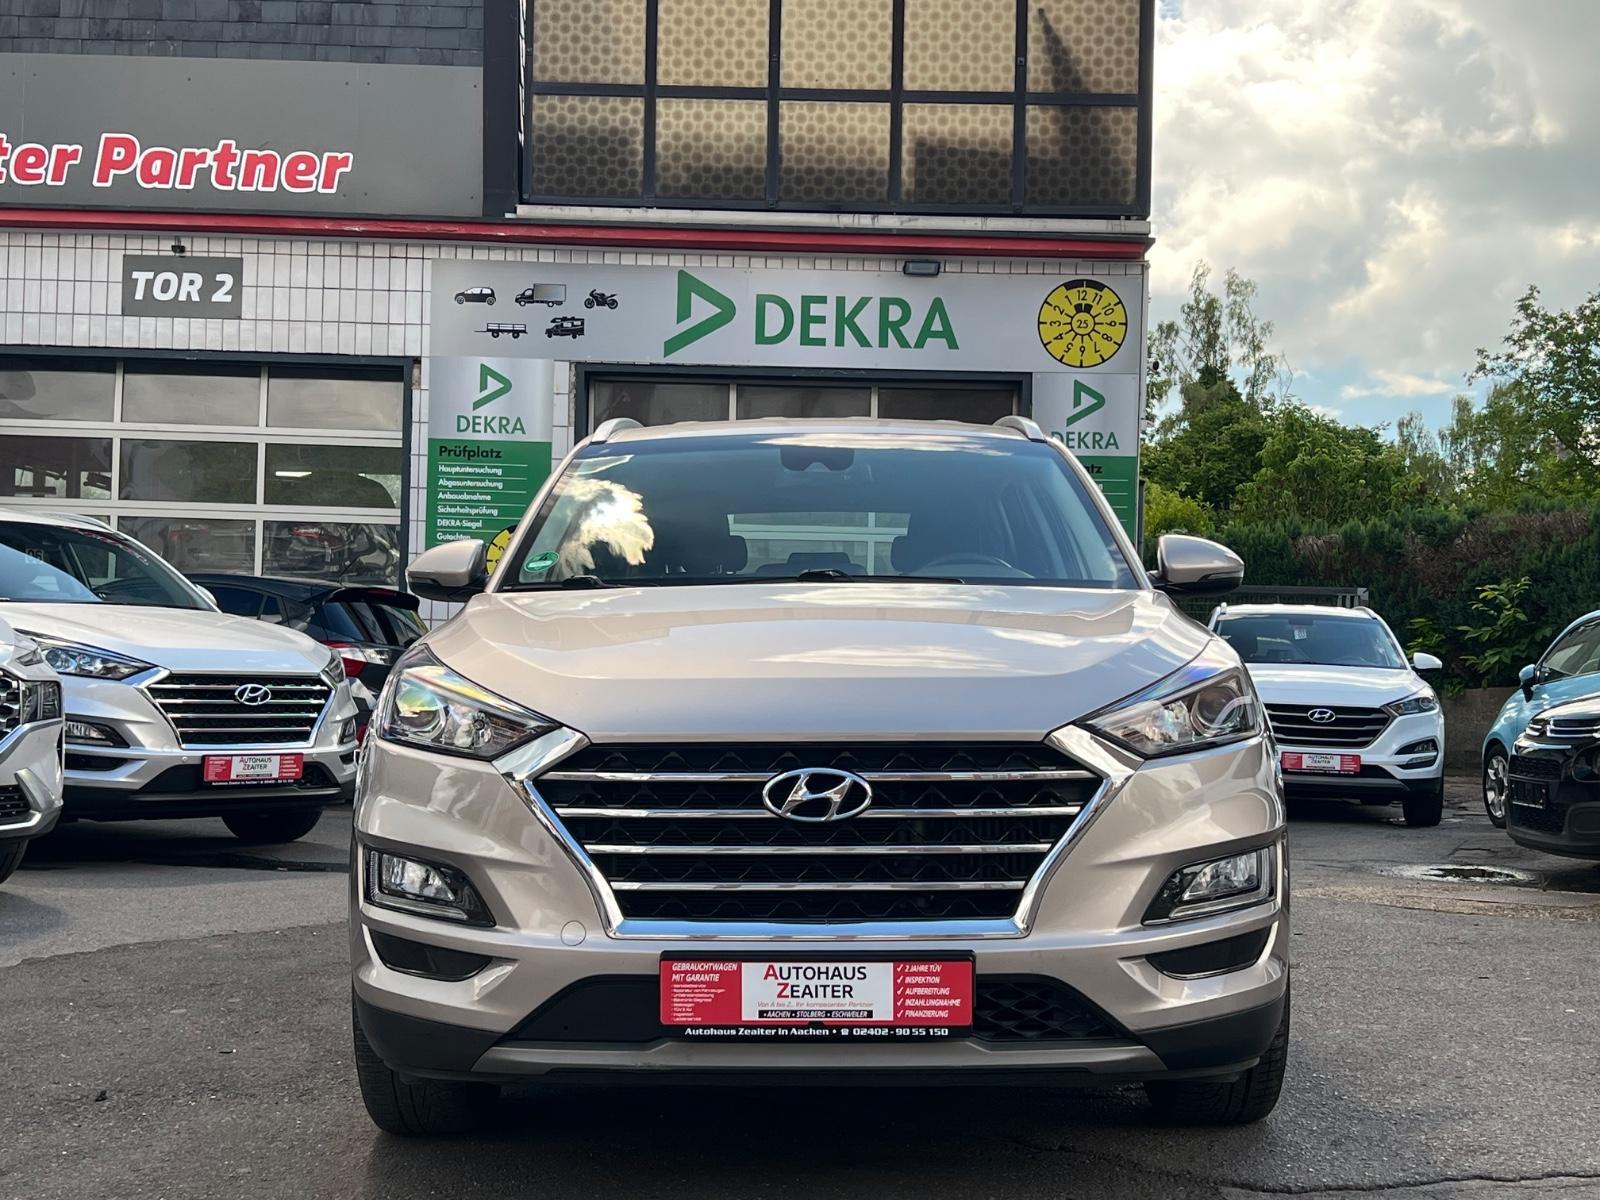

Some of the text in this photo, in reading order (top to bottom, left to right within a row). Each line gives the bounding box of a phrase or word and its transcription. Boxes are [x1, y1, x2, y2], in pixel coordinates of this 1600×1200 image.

[92, 132, 353, 193] Partner
[130, 270, 234, 302] TOR 2
[1077, 290, 1087, 300] 12
[1092, 293, 1102, 305] 11
[1053, 305, 1064, 315] 2
[1102, 303, 1114, 316] 10
[754, 294, 959, 350] DEKRA
[1077, 320, 1088, 328] 25
[1102, 333, 1112, 342] 8
[457, 415, 526, 434] DEKRA
[439, 446, 502, 460] Prüfplatz
[438, 465, 502, 475] Hauptuntersuchung
[438, 479, 503, 489] Abgasuntersuchung
[438, 492, 491, 500] Anbauabnahme
[437, 506, 498, 516] Sicherheitsprüfung
[437, 519, 482, 528] DEKRA-Siegel
[672, 962, 737, 971] GEBRAUCHTWAGEN
[930, 963, 942, 972] TÜV
[763, 964, 867, 980] AUTOHAUS
[672, 974, 720, 982] MIT GARANTIE
[776, 983, 854, 998] ZEAITER
[685, 1028, 736, 1036] Autohaus
[738, 1028, 776, 1036] Zeaiter
[778, 1028, 789, 1036] in
[790, 1028, 829, 1036] Aachen
[853, 1028, 888, 1036] 02402
[929, 1028, 948, 1036] 150
